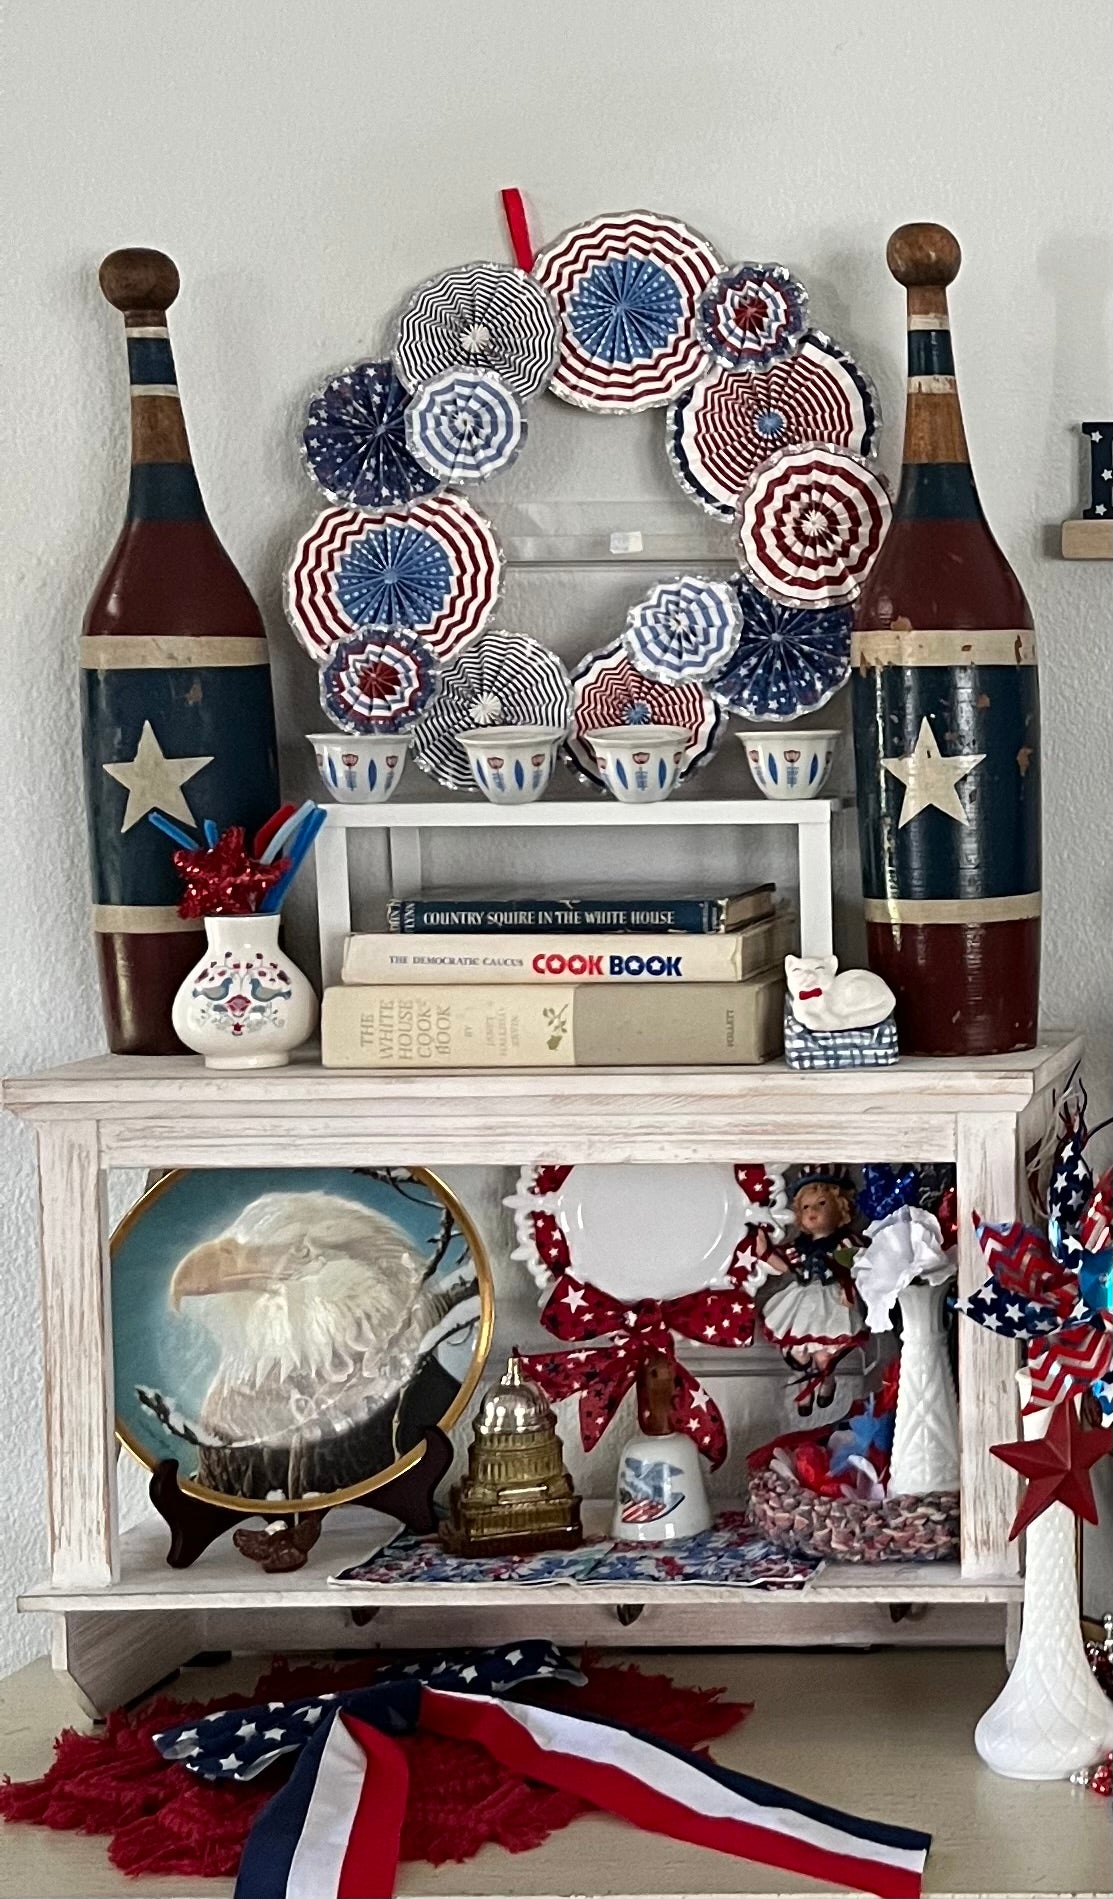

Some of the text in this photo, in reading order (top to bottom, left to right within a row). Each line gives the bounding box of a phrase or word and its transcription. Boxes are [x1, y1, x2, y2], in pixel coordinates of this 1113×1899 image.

[423, 910, 676, 927] COUNTRY SQUIRE IN THE WHITE HOUSE
[389, 953, 683, 977] THE DEMOCRATIC CAUCUS COOK BOOK
[360, 1013, 374, 1048] THE
[378, 999, 394, 1060] WHITE
[398, 999, 413, 1060] HOUSE
[435, 1005, 451, 1056] BOOK
